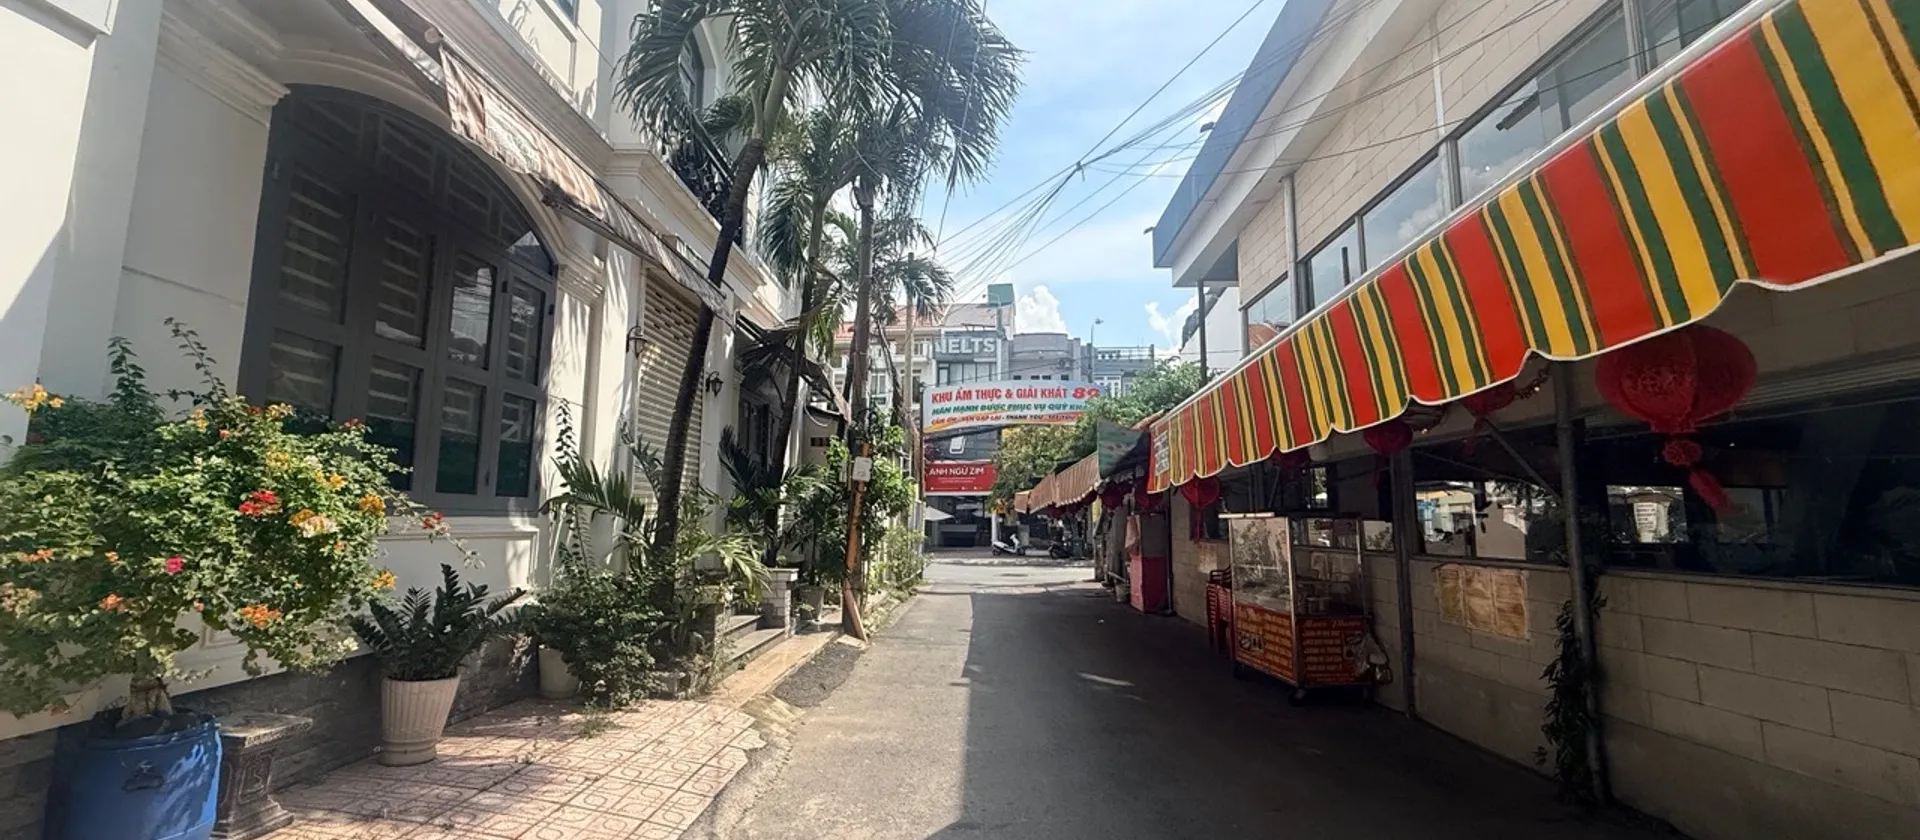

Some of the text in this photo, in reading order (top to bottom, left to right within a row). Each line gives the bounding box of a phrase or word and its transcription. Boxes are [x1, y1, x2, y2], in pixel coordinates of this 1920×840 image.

[932, 391, 953, 404] KHU
[975, 389, 1002, 402] THỰC
[1005, 388, 1013, 399] &
[1016, 385, 1038, 399] GIẢI
[1040, 386, 1068, 399] KHÁT
[969, 467, 984, 475] ZIM
